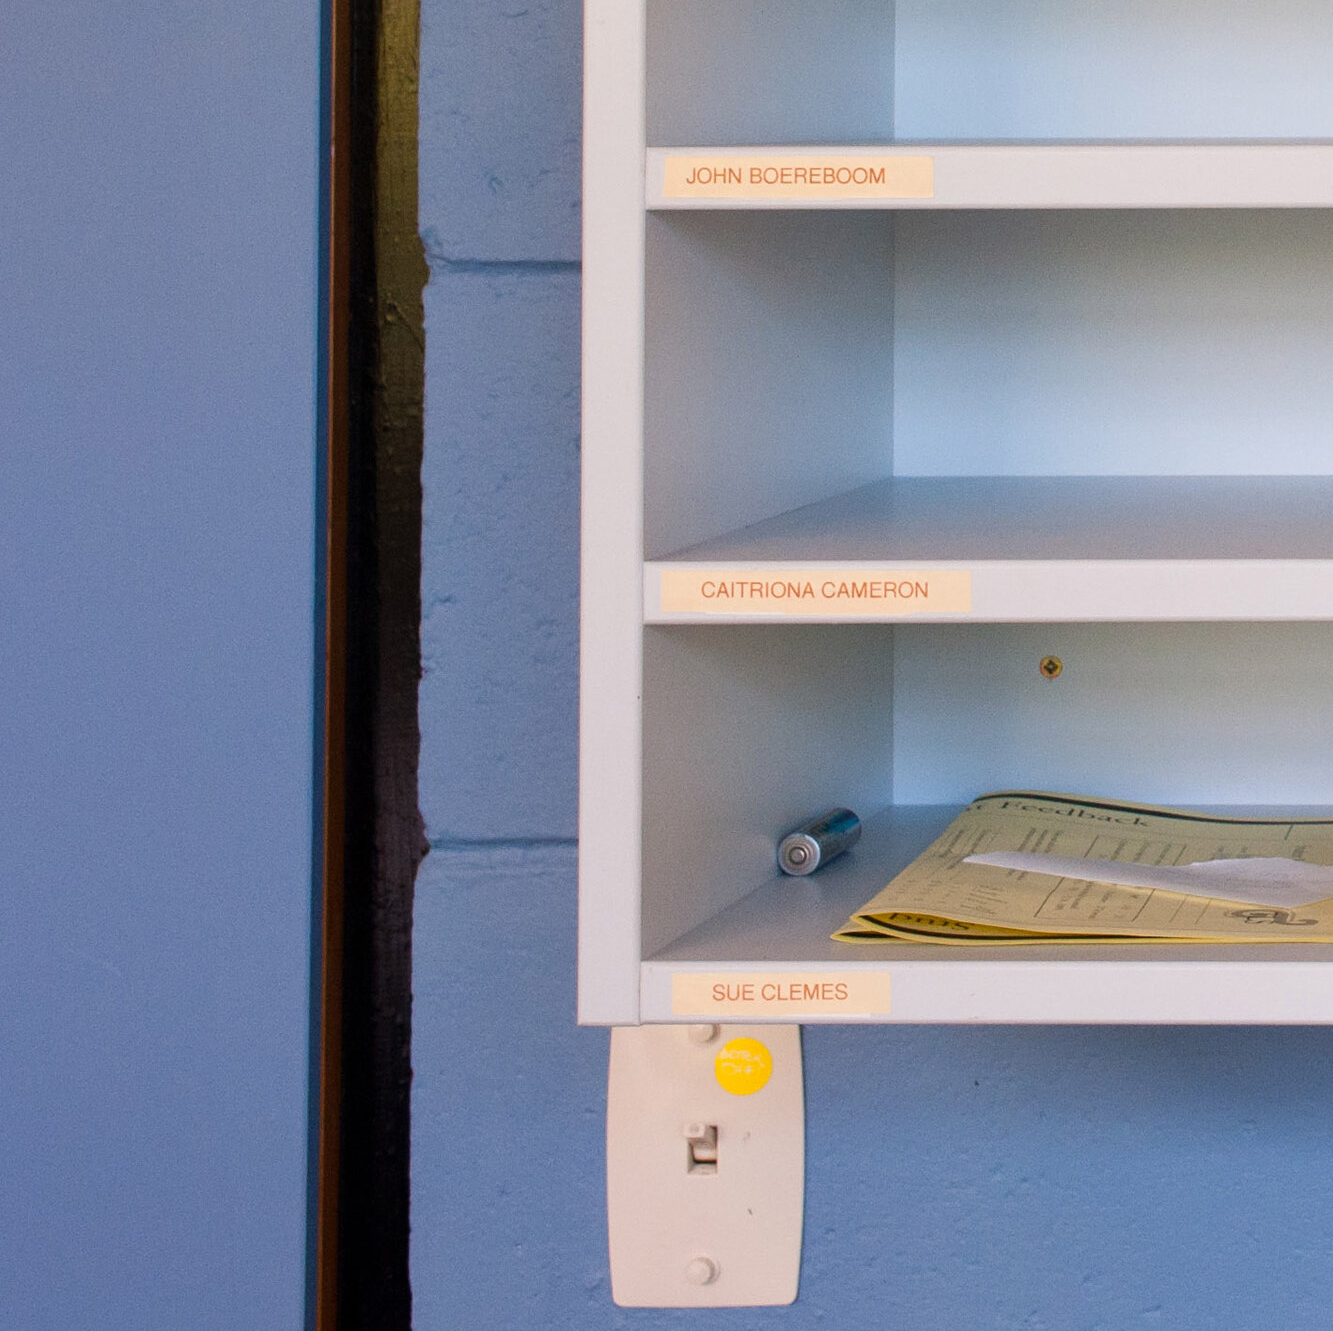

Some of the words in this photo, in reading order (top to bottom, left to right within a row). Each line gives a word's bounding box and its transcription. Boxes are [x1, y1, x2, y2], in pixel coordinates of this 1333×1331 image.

[686, 167, 742, 185] JOHN
[750, 167, 886, 185] BOEREBOOM
[700, 581, 815, 599] CAITRIONA
[821, 581, 929, 599] CAMERON
[1001, 801, 1150, 827] Feedback
[712, 983, 755, 1001] SUE
[761, 982, 849, 1001] CLEMES
